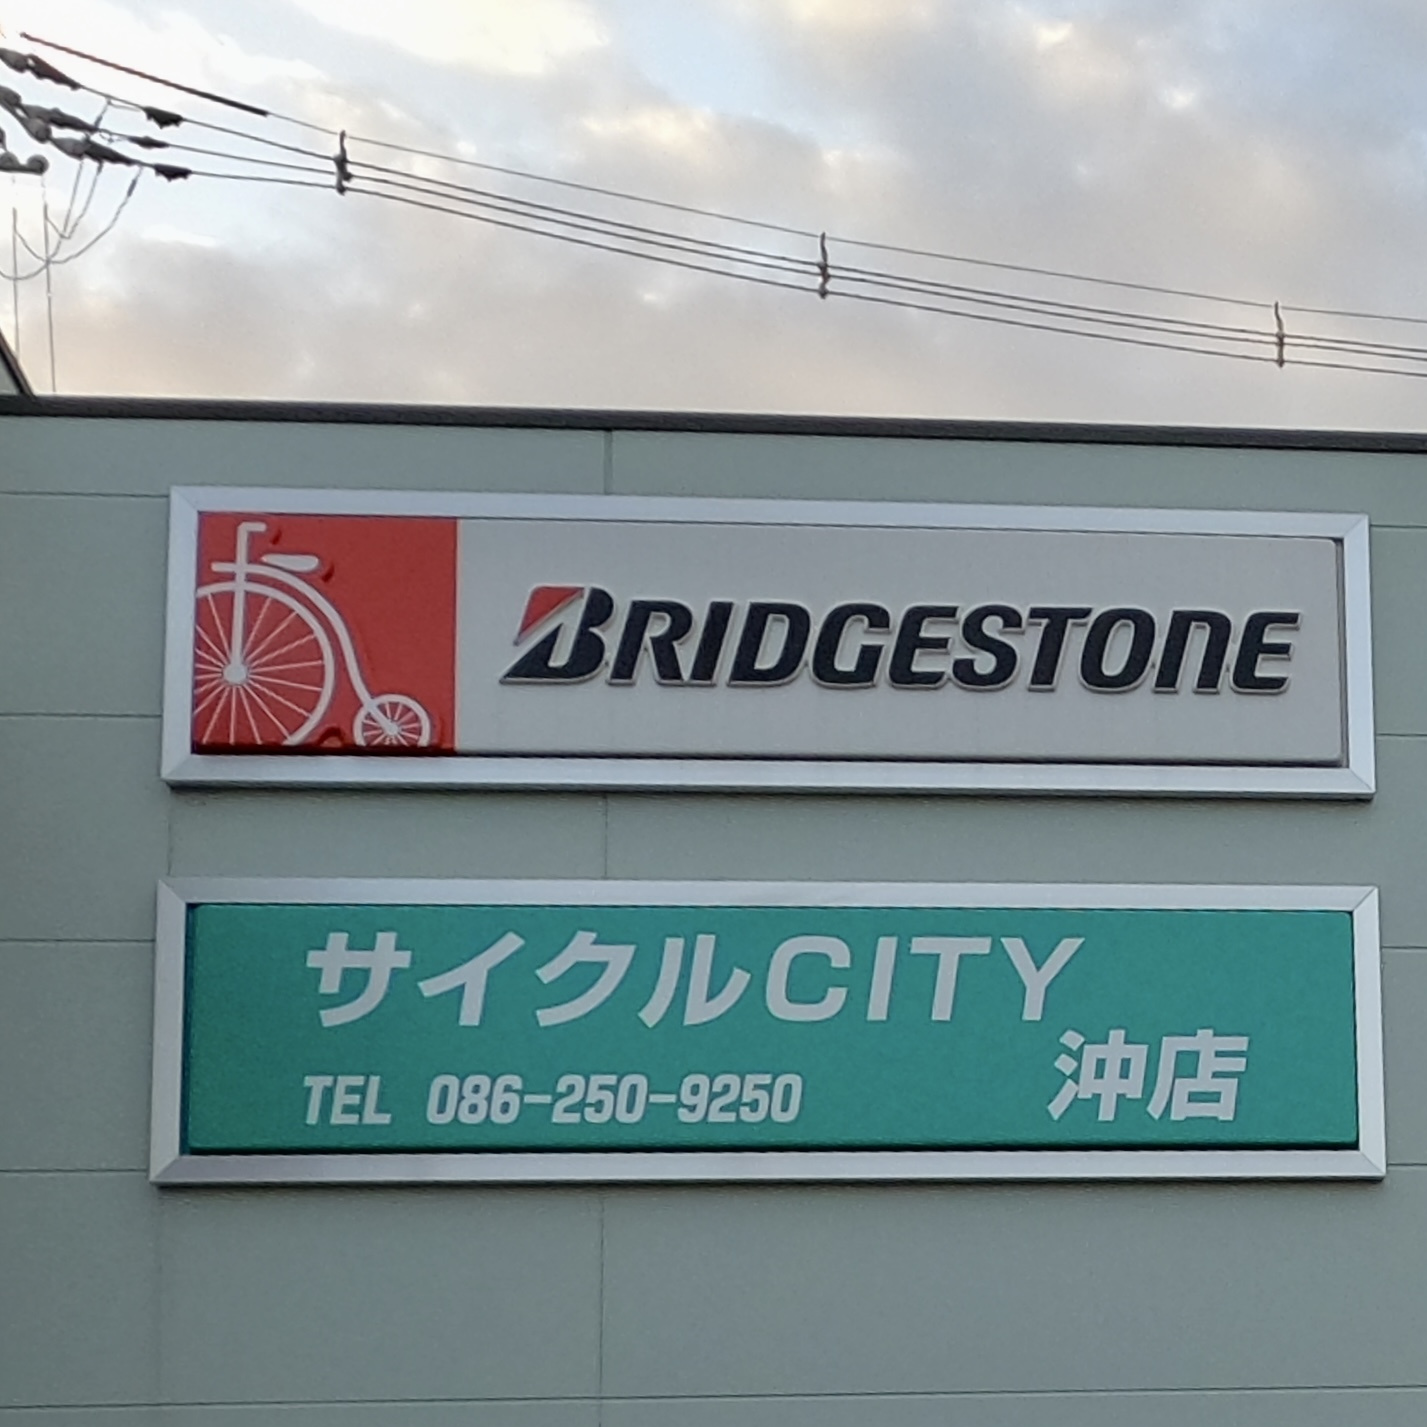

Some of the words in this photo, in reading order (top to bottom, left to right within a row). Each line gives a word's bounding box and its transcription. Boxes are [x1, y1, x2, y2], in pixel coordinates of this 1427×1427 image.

[500, 586, 1300, 694] BRIDGESTONE
[304, 930, 1084, 1029] サイクルCITY
[302, 1075, 391, 1126] TEL
[427, 1072, 803, 1125] 086-250-9250
[1046, 1027, 1250, 1123] 沖店
